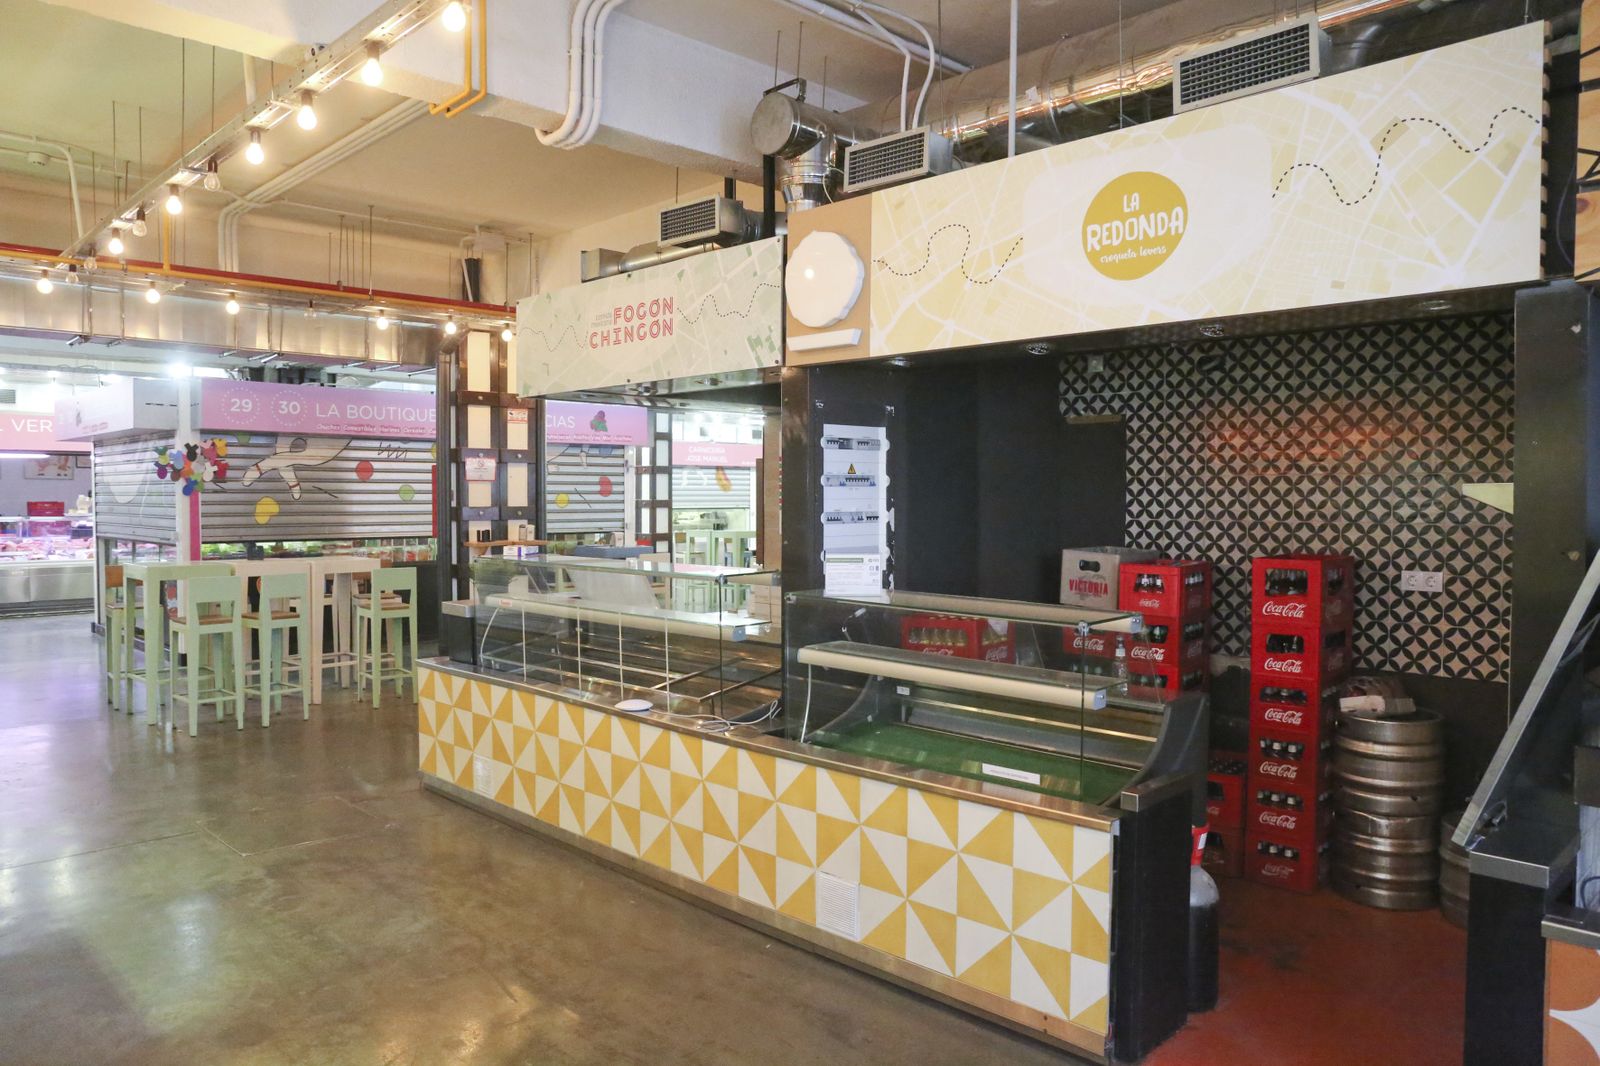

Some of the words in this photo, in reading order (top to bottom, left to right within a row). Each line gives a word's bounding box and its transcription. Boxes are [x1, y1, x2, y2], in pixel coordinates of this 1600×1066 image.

[1123, 192, 1140, 213] LA
[1086, 206, 1184, 252] REDONDA
[1100, 248, 1137, 264] croqueta
[1140, 245, 1167, 257] lovers
[230, 398, 252, 412] 29
[278, 401, 300, 415] 30
[316, 403, 340, 418] LA
[347, 404, 436, 422] BOUTIQUE
[11, 418, 53, 432] VER
[1069, 578, 1108, 597] VICTORIA
[1262, 601, 1307, 618] Coca-Cola
[1130, 646, 1165, 661] Coca-Cola
[1264, 657, 1303, 673] Coca-Cola
[1264, 708, 1303, 725] Coca-Cola
[1259, 761, 1298, 778] Coca-Cola
[1259, 811, 1297, 829] Coca-Cola
